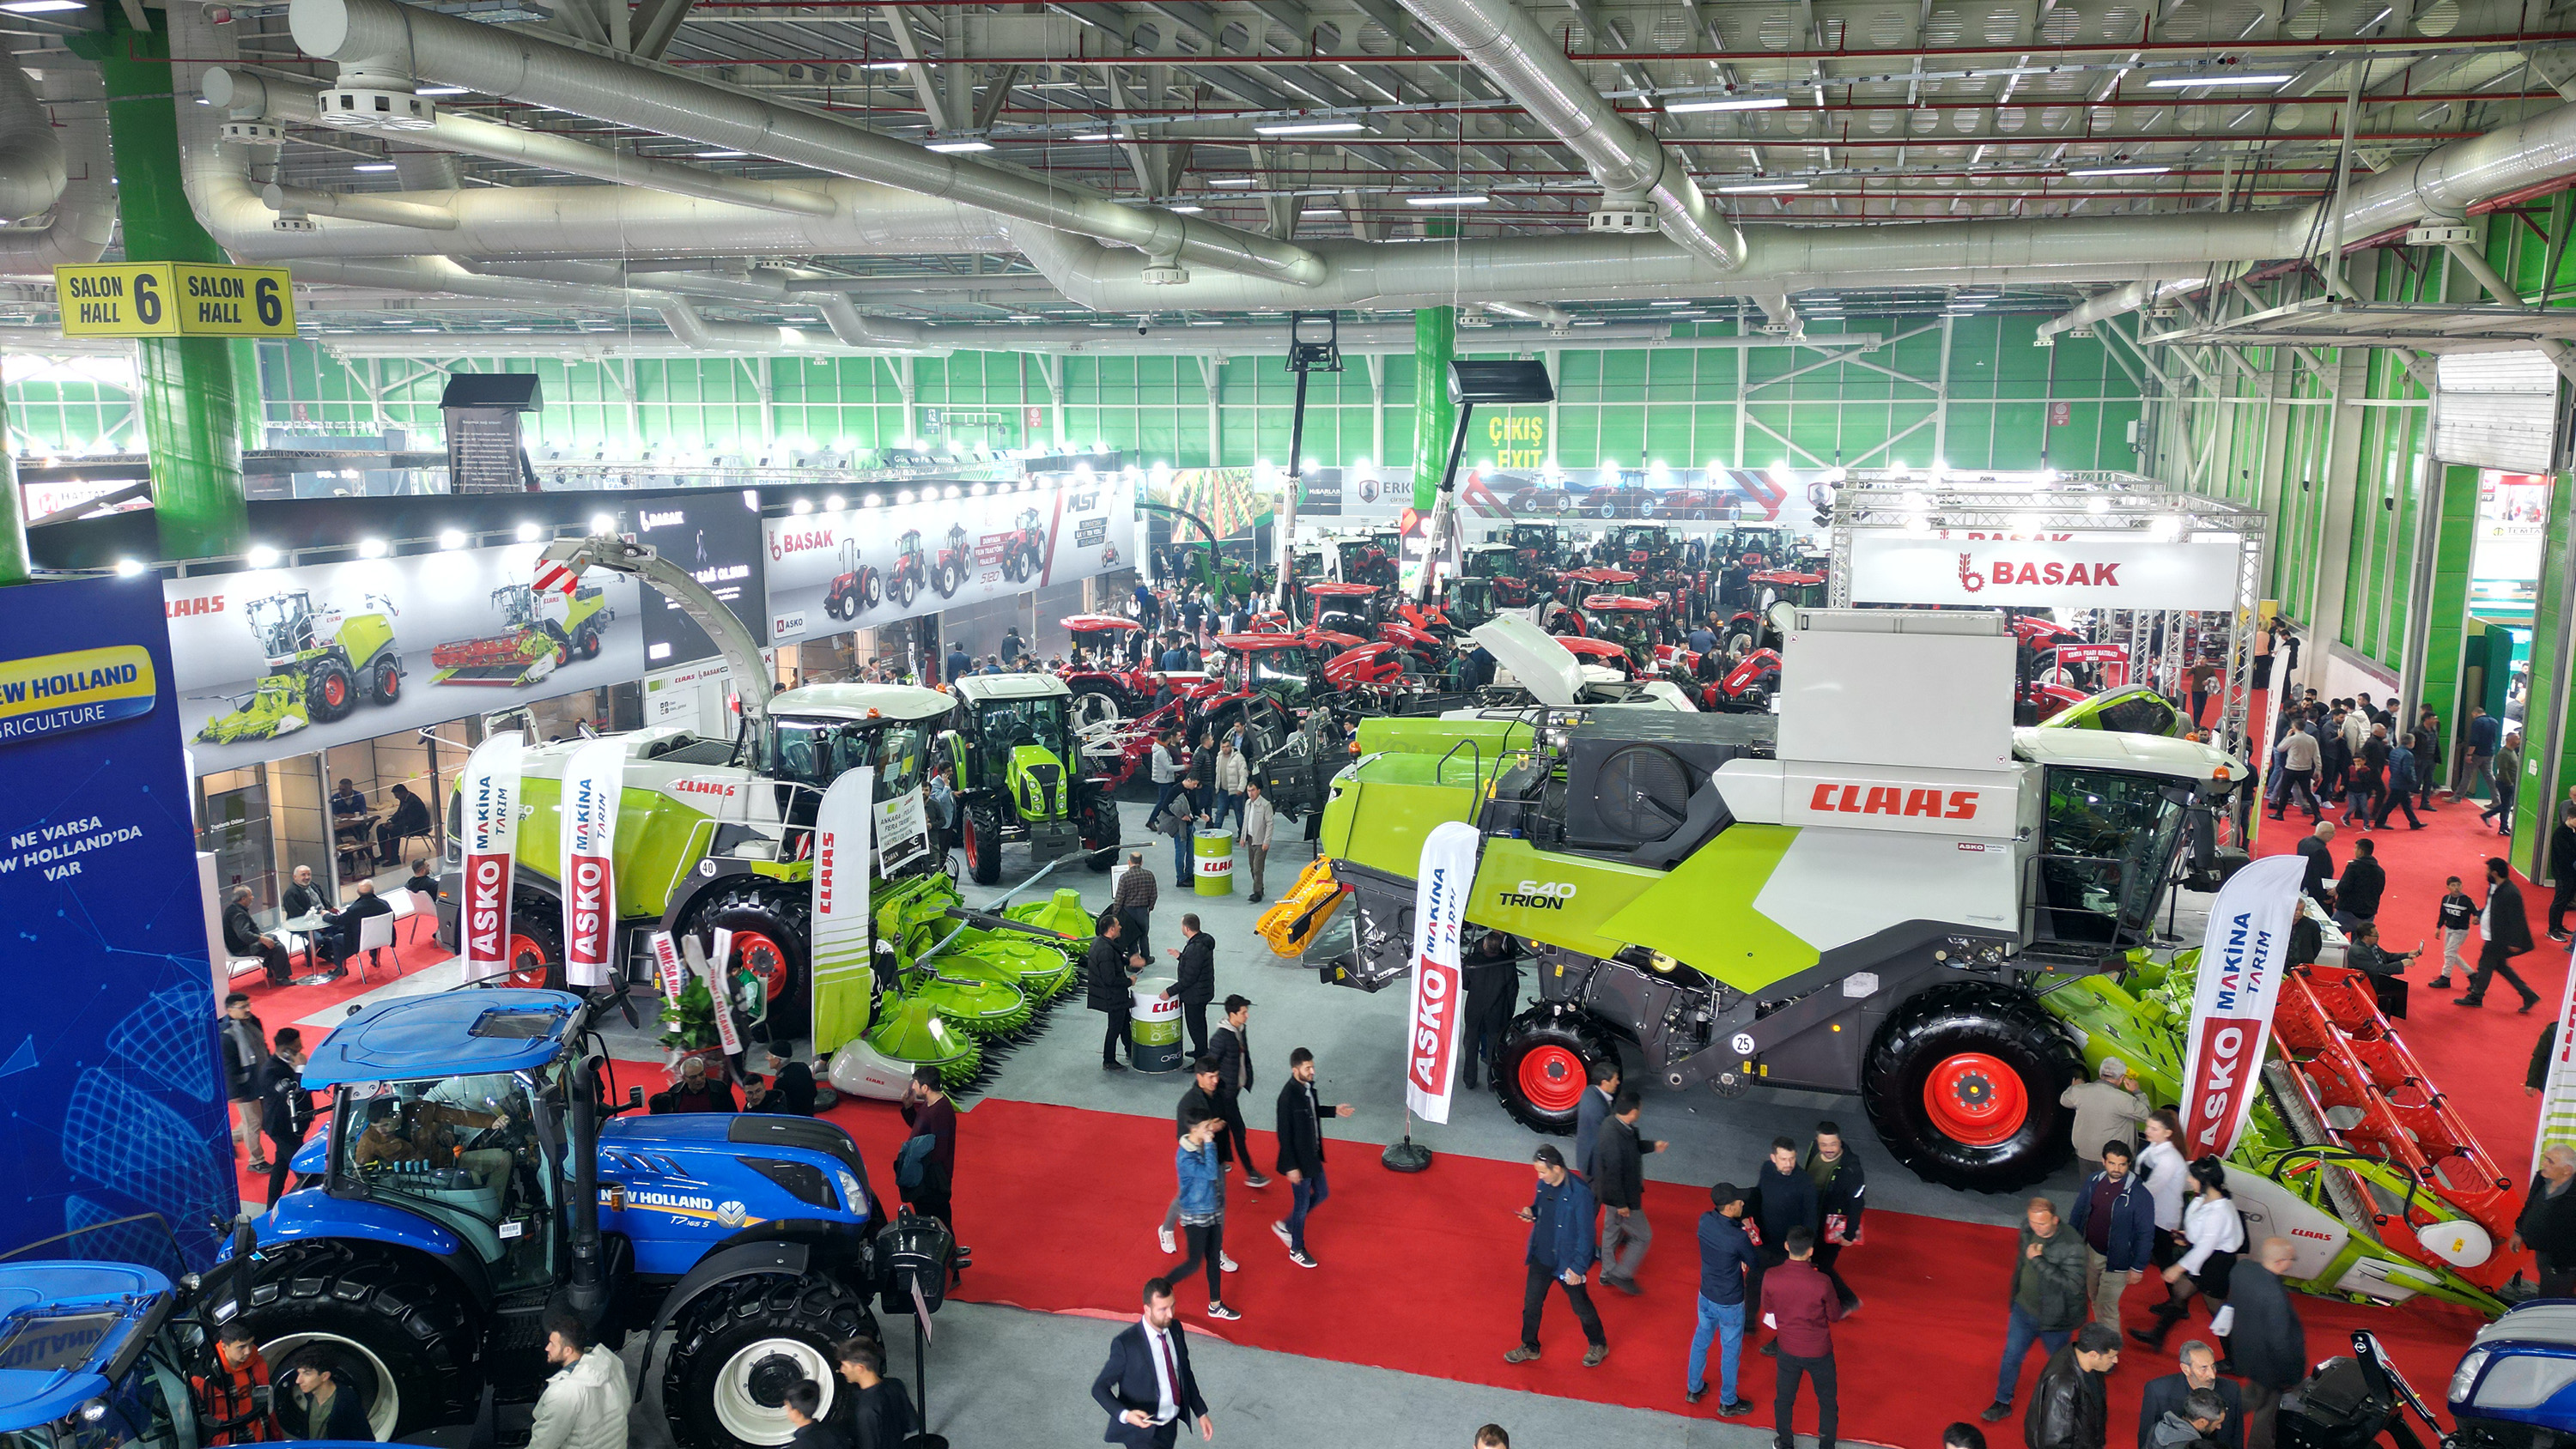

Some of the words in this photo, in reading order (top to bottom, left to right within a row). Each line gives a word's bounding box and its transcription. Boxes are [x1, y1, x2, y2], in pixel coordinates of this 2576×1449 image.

[70, 275, 123, 298] SALON
[188, 276, 245, 299] SALON
[134, 274, 161, 325] 6
[257, 277, 283, 327] 6
[80, 302, 120, 324] HALL
[199, 302, 241, 324] HALL
[1489, 417, 1543, 446] ÇIKIŞ
[1498, 450, 1543, 468] EXIT
[1383, 482, 1414, 494] ERK
[1067, 491, 1100, 513] MST
[783, 529, 834, 552] BASAK
[1992, 561, 2121, 587] BASAK
[165, 595, 224, 618] LAAS
[785, 617, 803, 631] ASKO
[32, 664, 137, 699] HOLLAND
[675, 674, 696, 683] CLAAS
[702, 667, 720, 677] BASAK
[676, 780, 736, 797] CLAAS
[477, 775, 491, 850] MAKİNA
[495, 787, 507, 835] TARIM
[1809, 783, 1979, 820] CLAAS
[576, 779, 592, 850] MAKİNA
[597, 793, 606, 839] TARIM
[11, 831, 38, 850] NE
[41, 815, 103, 841] VARSA
[23, 825, 143, 867] HOLLAND'DA
[44, 861, 82, 882] VAR
[702, 862, 714, 875] 40
[819, 833, 835, 914] CLAAS
[1499, 892, 1564, 910] TRION
[1518, 880, 1577, 899] 640
[471, 861, 500, 955] ASKO
[574, 862, 602, 957] ASKO
[1426, 868, 1444, 954] MAKİNA
[2216, 912, 2251, 1010] MAKİNA
[2246, 930, 2272, 994] TARIM
[1414, 967, 1448, 1084] ASKO
[1736, 1037, 1751, 1052] 25
[866, 1076, 885, 1086] CLAAS
[2200, 1027, 2243, 1147] ASKO
[601, 1190, 637, 1203] NW
[641, 1192, 713, 1210] HOLLAND
[2291, 1228, 2332, 1241] CLAAS
